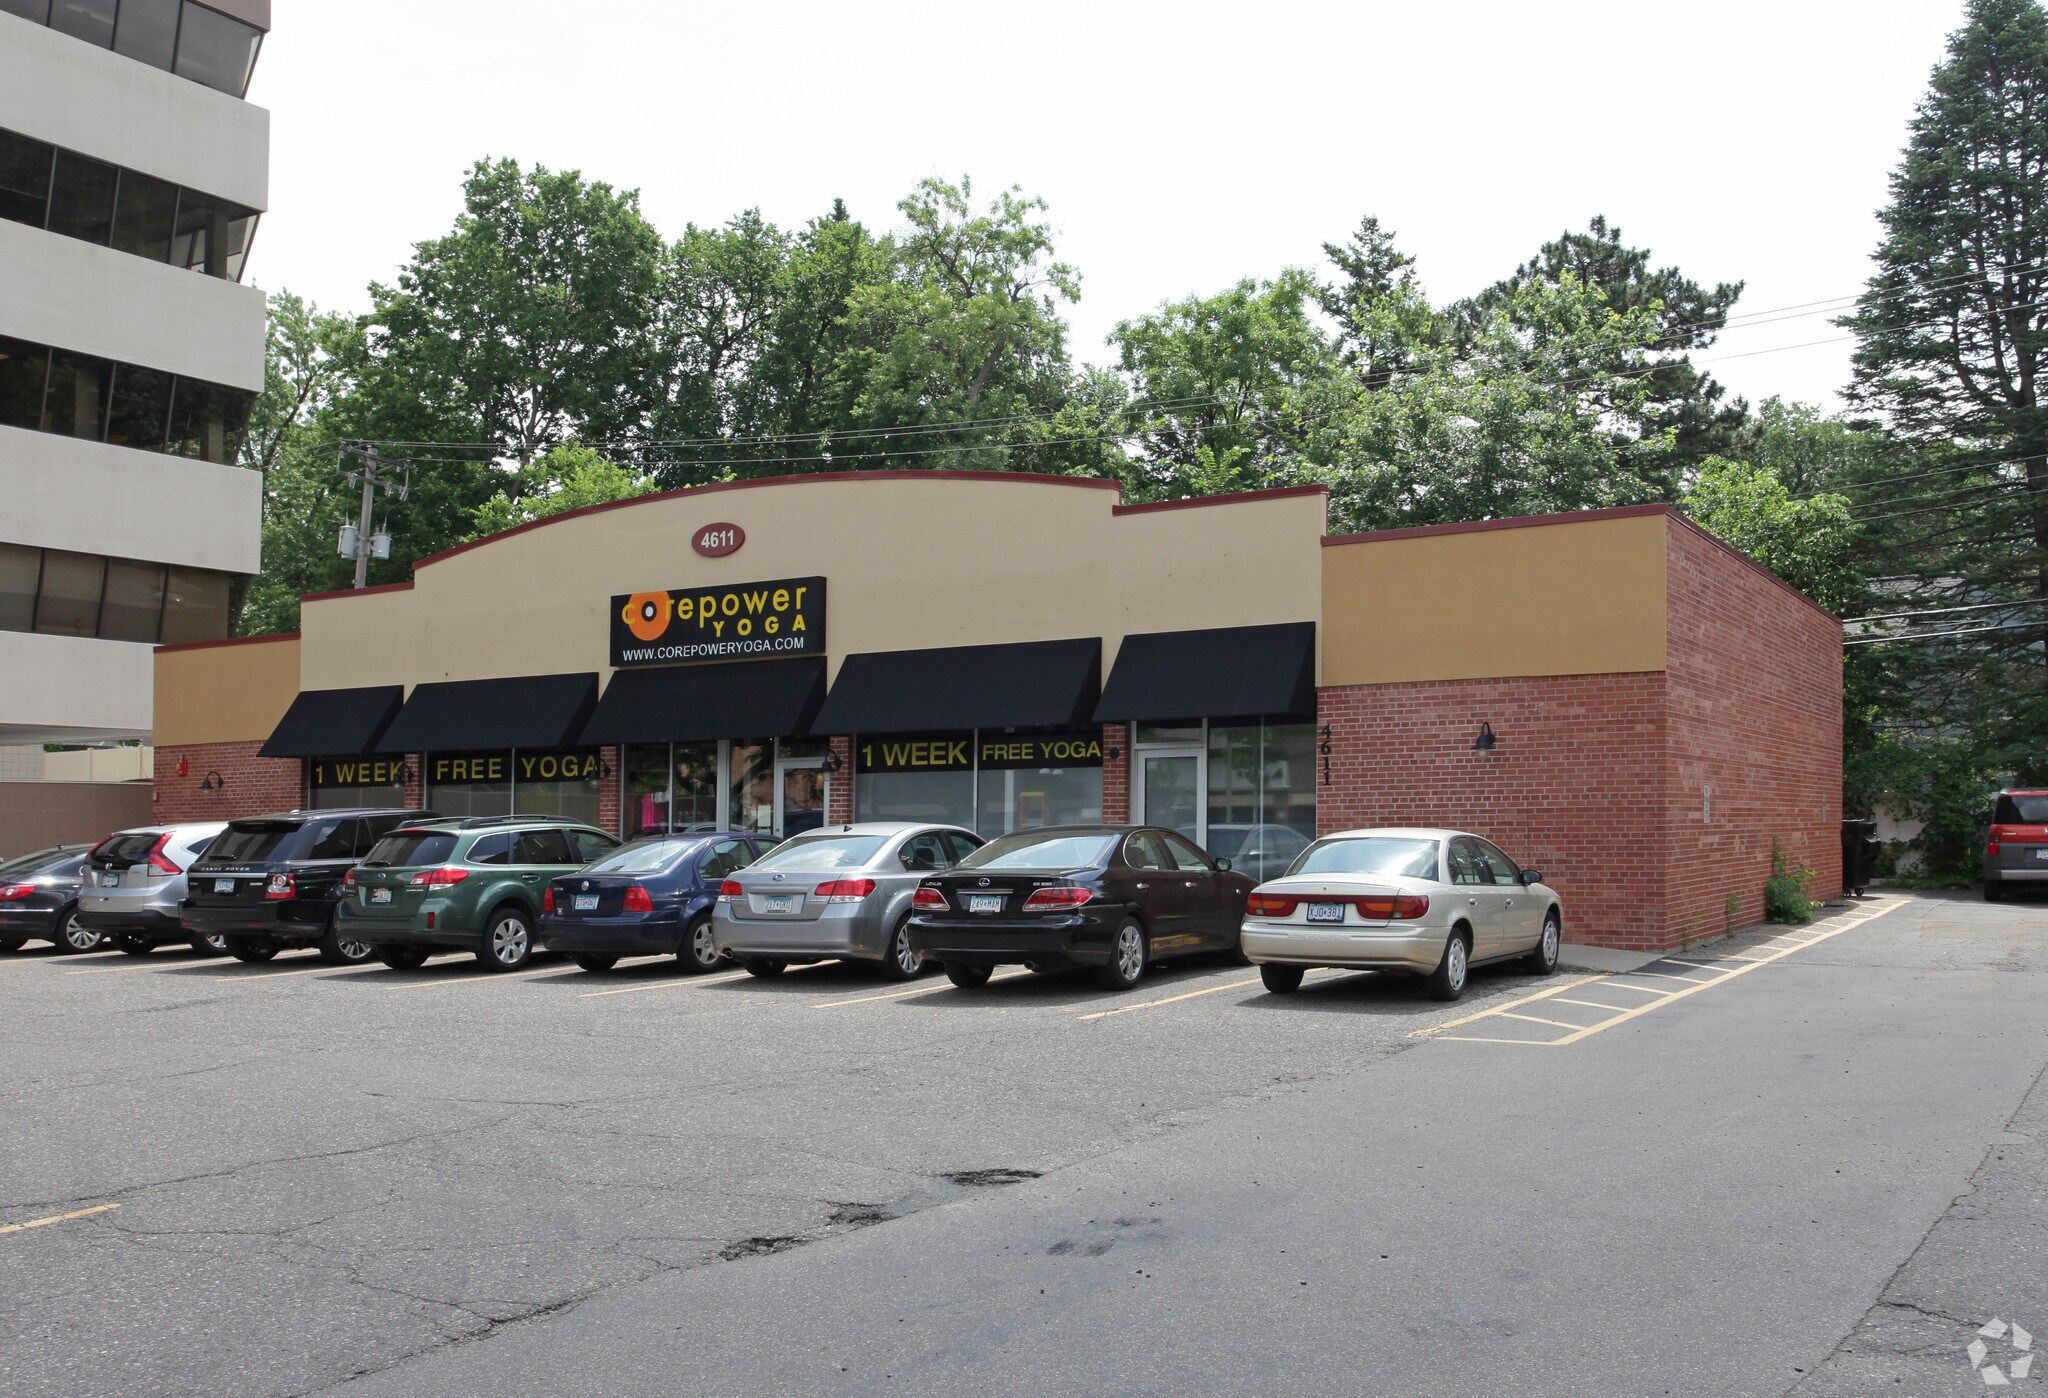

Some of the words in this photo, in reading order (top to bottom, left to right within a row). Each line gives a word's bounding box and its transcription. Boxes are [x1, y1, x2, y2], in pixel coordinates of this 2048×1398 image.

[701, 529, 735, 549] 4611
[712, 614, 806, 638] YOGA
[622, 636, 804, 661] WWW.COREPOWERYOGA.COM
[862, 744, 872, 767] 1
[882, 741, 968, 767] WEEK
[982, 743, 1034, 761] FREE
[1040, 741, 1101, 759] YOGA
[1321, 724, 1332, 786] 4611
[315, 765, 323, 784] 1
[335, 761, 404, 783] WEEK
[436, 757, 502, 781] FREE
[521, 754, 598, 778] YOGA
